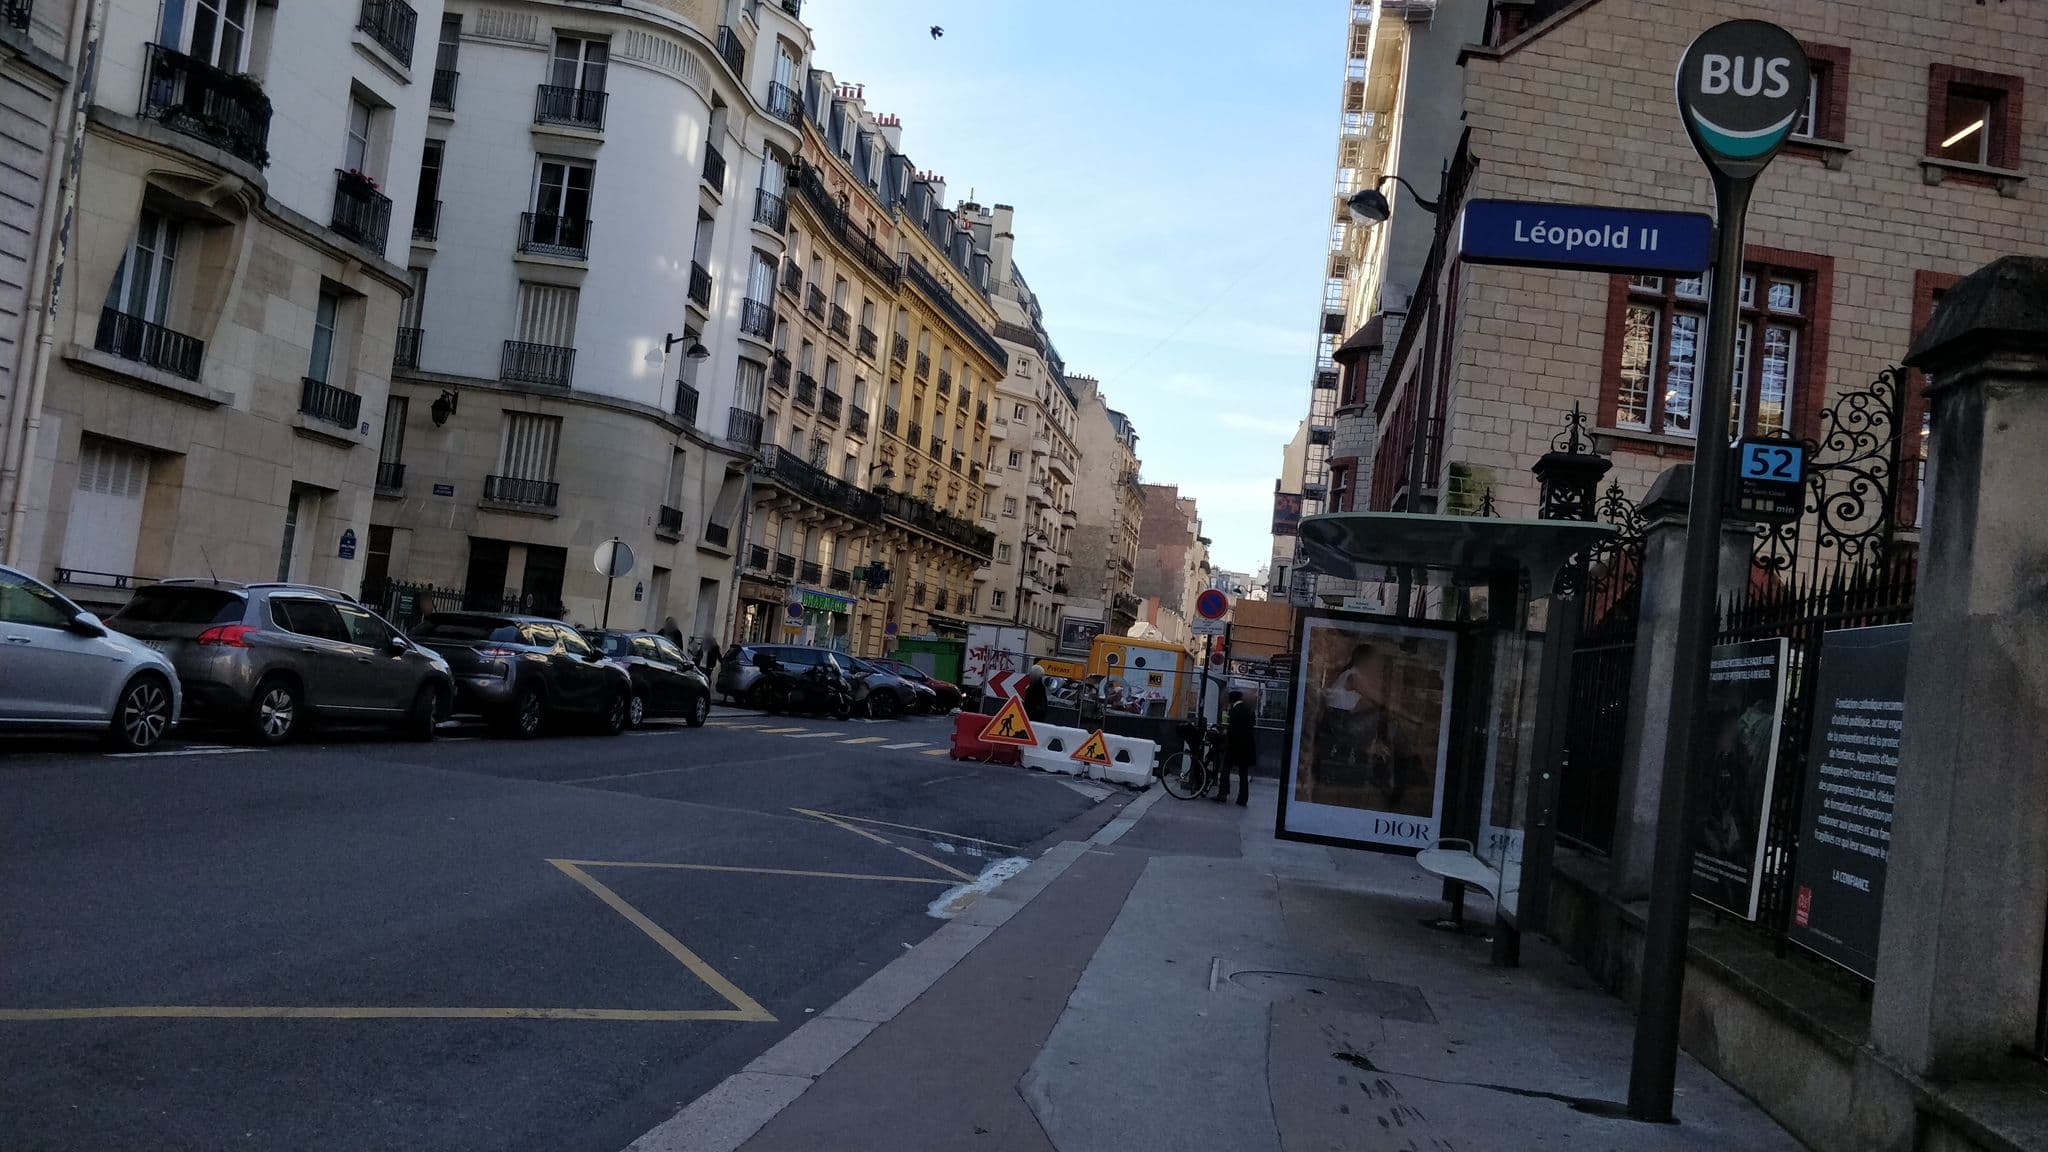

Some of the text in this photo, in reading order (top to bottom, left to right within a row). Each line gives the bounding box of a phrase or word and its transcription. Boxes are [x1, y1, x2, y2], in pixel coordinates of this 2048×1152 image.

[1700, 54, 1790, 98] BUS
[1514, 220, 1658, 251] Léopold II
[1749, 447, 1793, 478] 52
[1776, 505, 1795, 513] min
[1374, 818, 1430, 841] DIOR
[1832, 869, 1839, 880] LA
